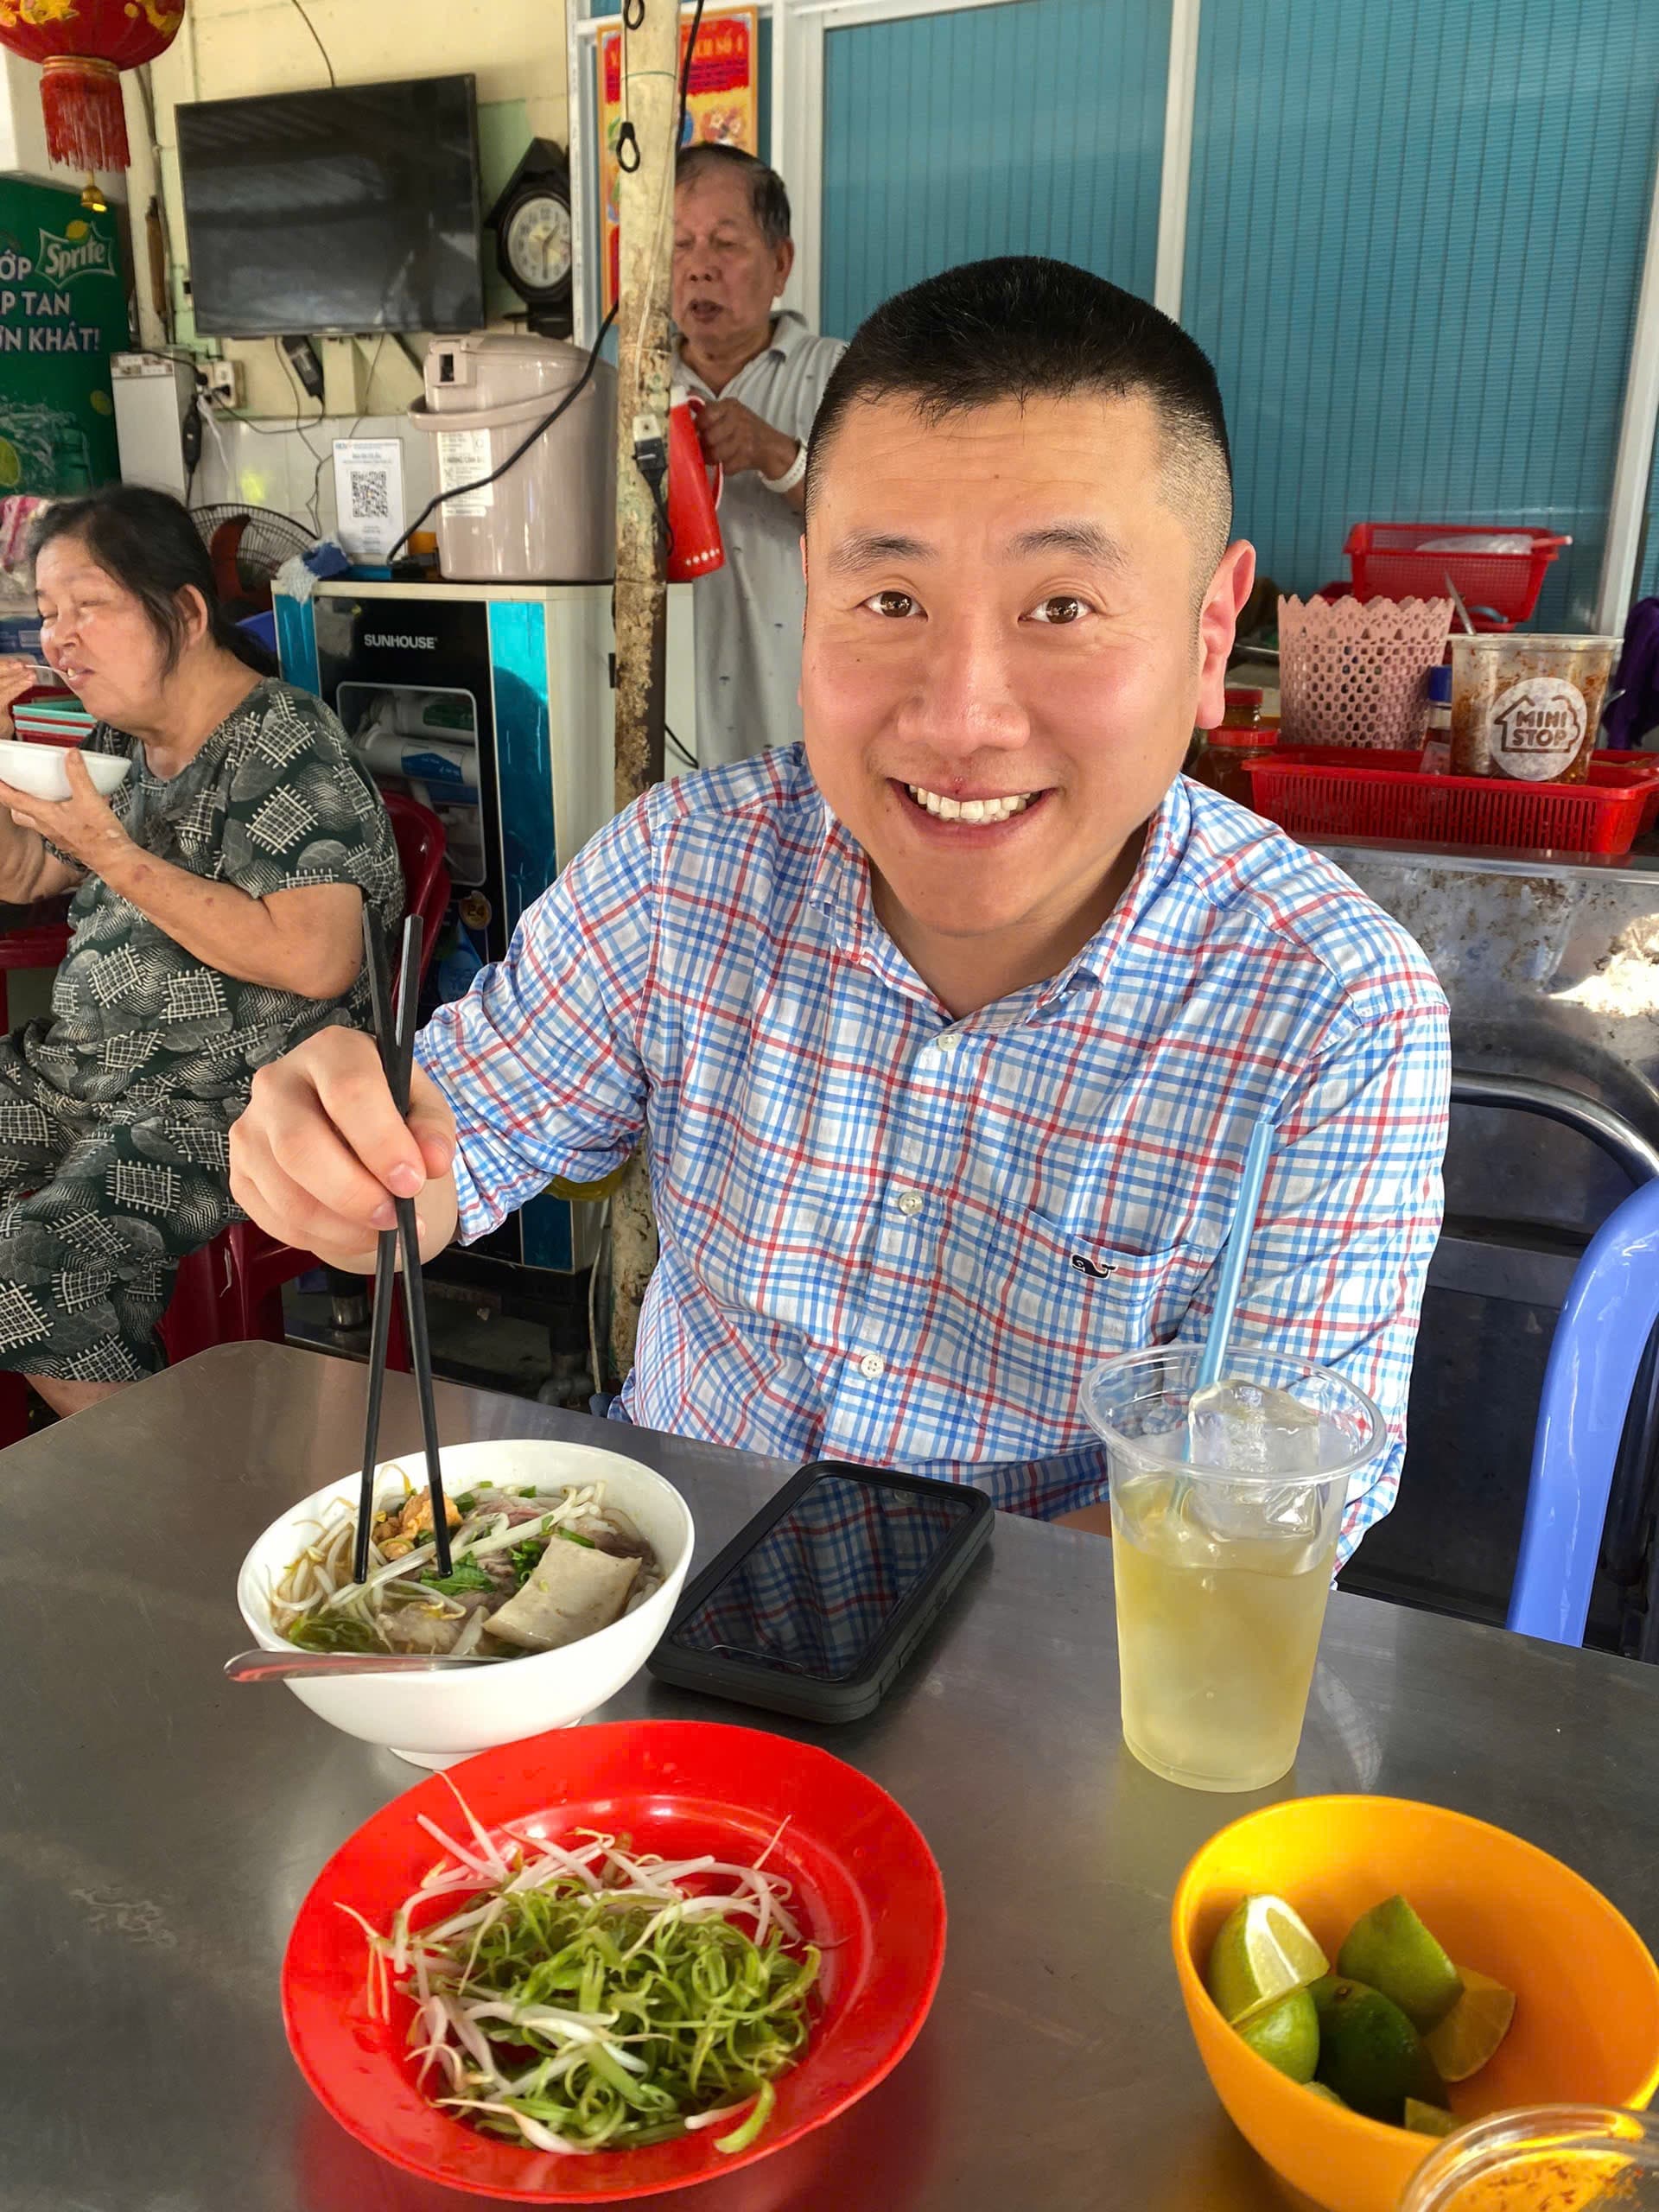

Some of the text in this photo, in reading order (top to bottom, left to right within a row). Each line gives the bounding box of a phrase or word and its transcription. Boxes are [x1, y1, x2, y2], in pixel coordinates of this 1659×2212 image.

[45, 235, 105, 278] Sprite
[21, 291, 70, 315] TAN
[28, 321, 99, 352] KHÁT!
[364, 633, 435, 649] SUNHOUSE
[1516, 710, 1567, 728] MINI
[1512, 728, 1567, 747] STOP
